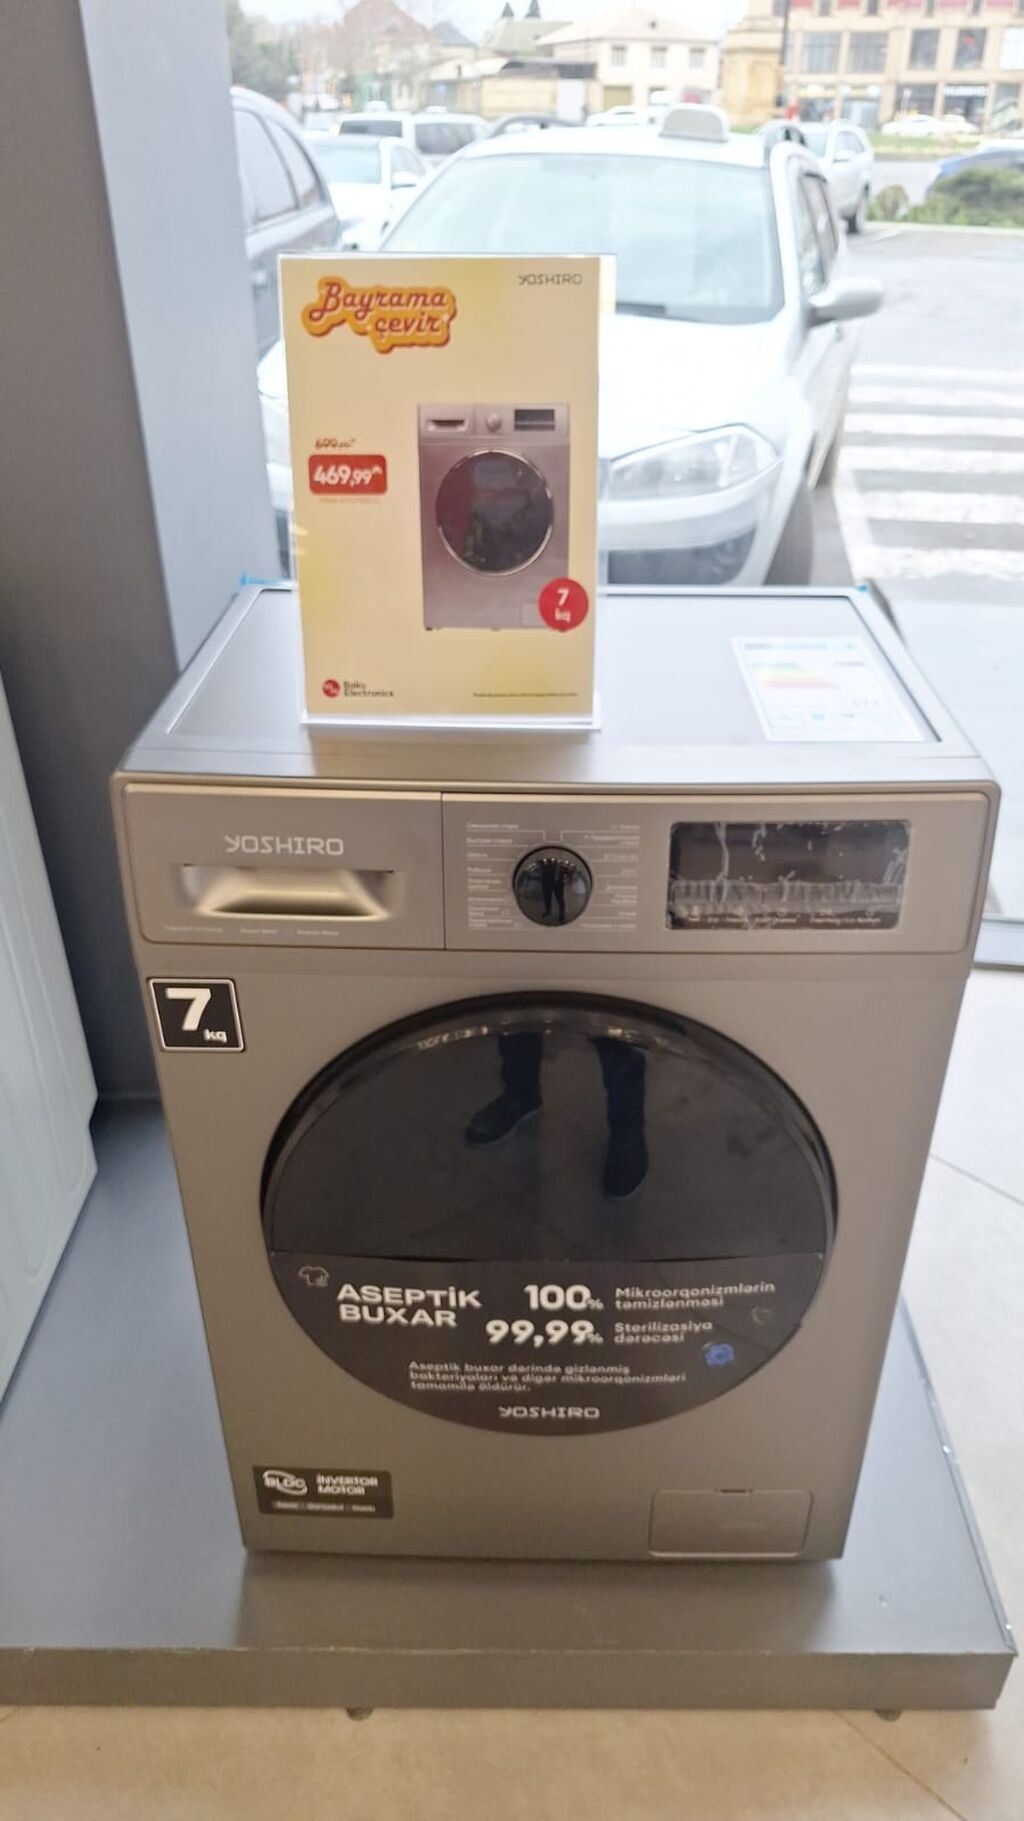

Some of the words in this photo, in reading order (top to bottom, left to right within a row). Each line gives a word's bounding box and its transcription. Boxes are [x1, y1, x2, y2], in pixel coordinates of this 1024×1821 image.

[518, 274, 583, 286] YOSHIRO
[309, 282, 447, 321] Bayrama
[374, 311, 441, 341] çevir
[557, 588, 569, 606] 7
[343, 689, 394, 698] Electronics
[224, 834, 345, 857] YOSHIRO
[165, 987, 212, 1031] 7
[336, 1284, 482, 1310] ASEPTİK
[338, 1303, 458, 1329] BUXAR
[614, 1320, 713, 1334] Sterilizasiya
[408, 1361, 461, 1373] Aseptik
[464, 1363, 504, 1373] buxar
[499, 1405, 600, 1419] YOSHIRO
[318, 1485, 365, 1495] MOTOR
